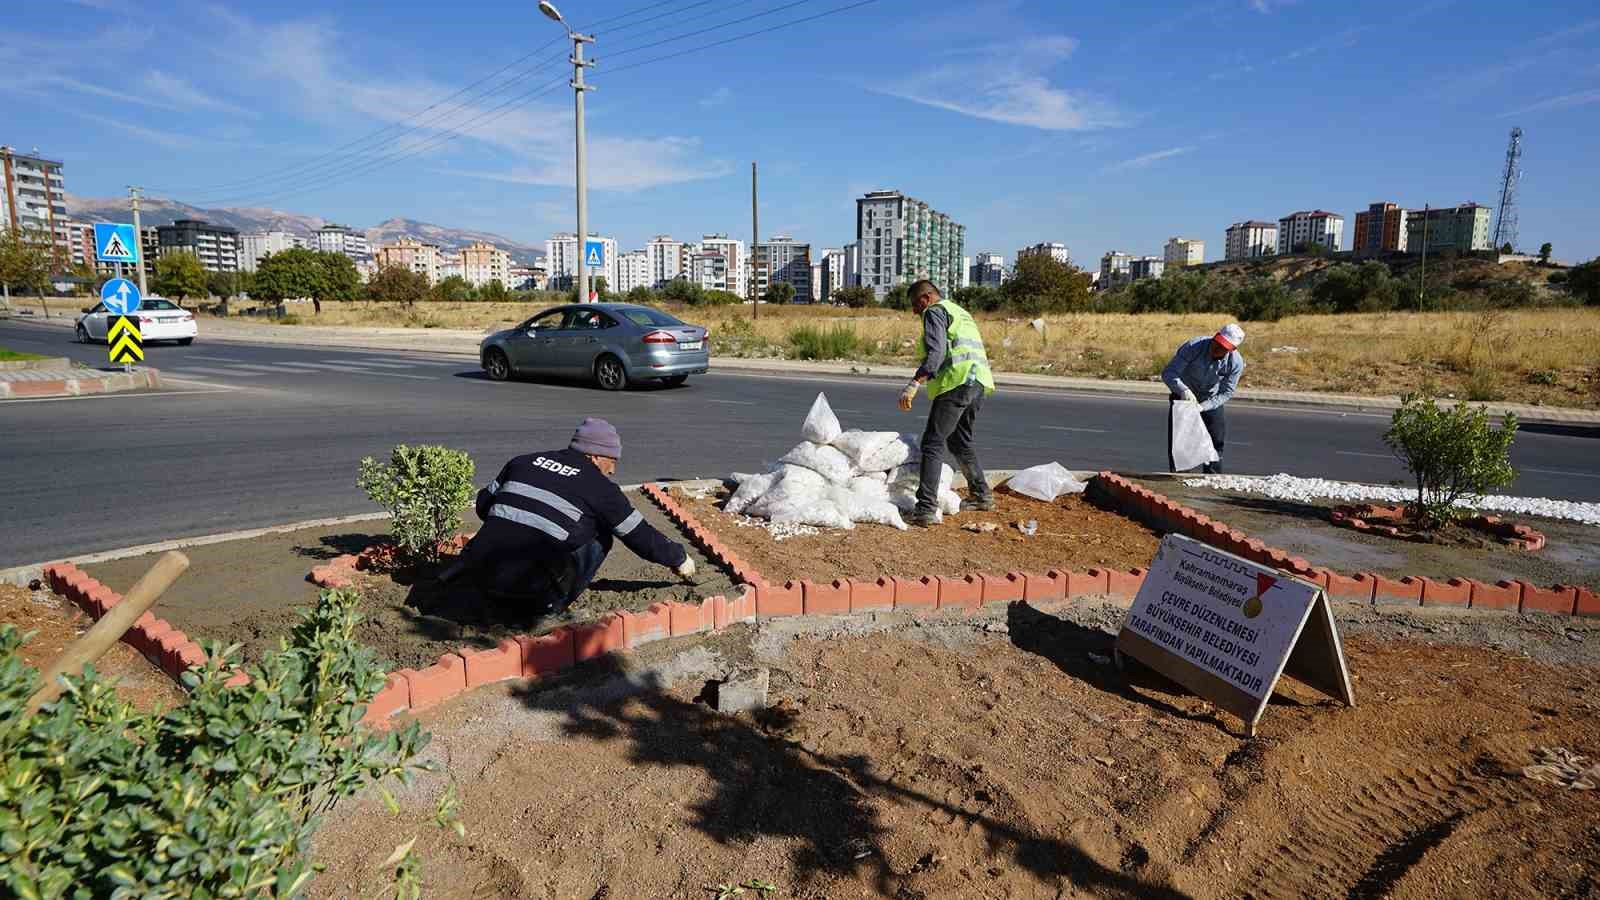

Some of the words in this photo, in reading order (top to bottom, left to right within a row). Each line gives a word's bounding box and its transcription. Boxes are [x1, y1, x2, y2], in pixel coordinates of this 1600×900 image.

[532, 456, 581, 477] SEDEF
[1173, 571, 1209, 593] Büyükşehir
[1208, 586, 1244, 609] Belediyesi
[1178, 559, 1249, 595] Kahramanmaraş
[1146, 603, 1201, 637] BÜYÜKŞEHİR
[1202, 628, 1260, 667] BELEDİYESİ
[1161, 591, 1192, 613] ÇEVRE
[1191, 603, 1259, 644] DÜZENLEMESİ
[1130, 615, 1184, 650] TARAFINDAN
[1185, 641, 1263, 692] YAPILMAKTADIR
